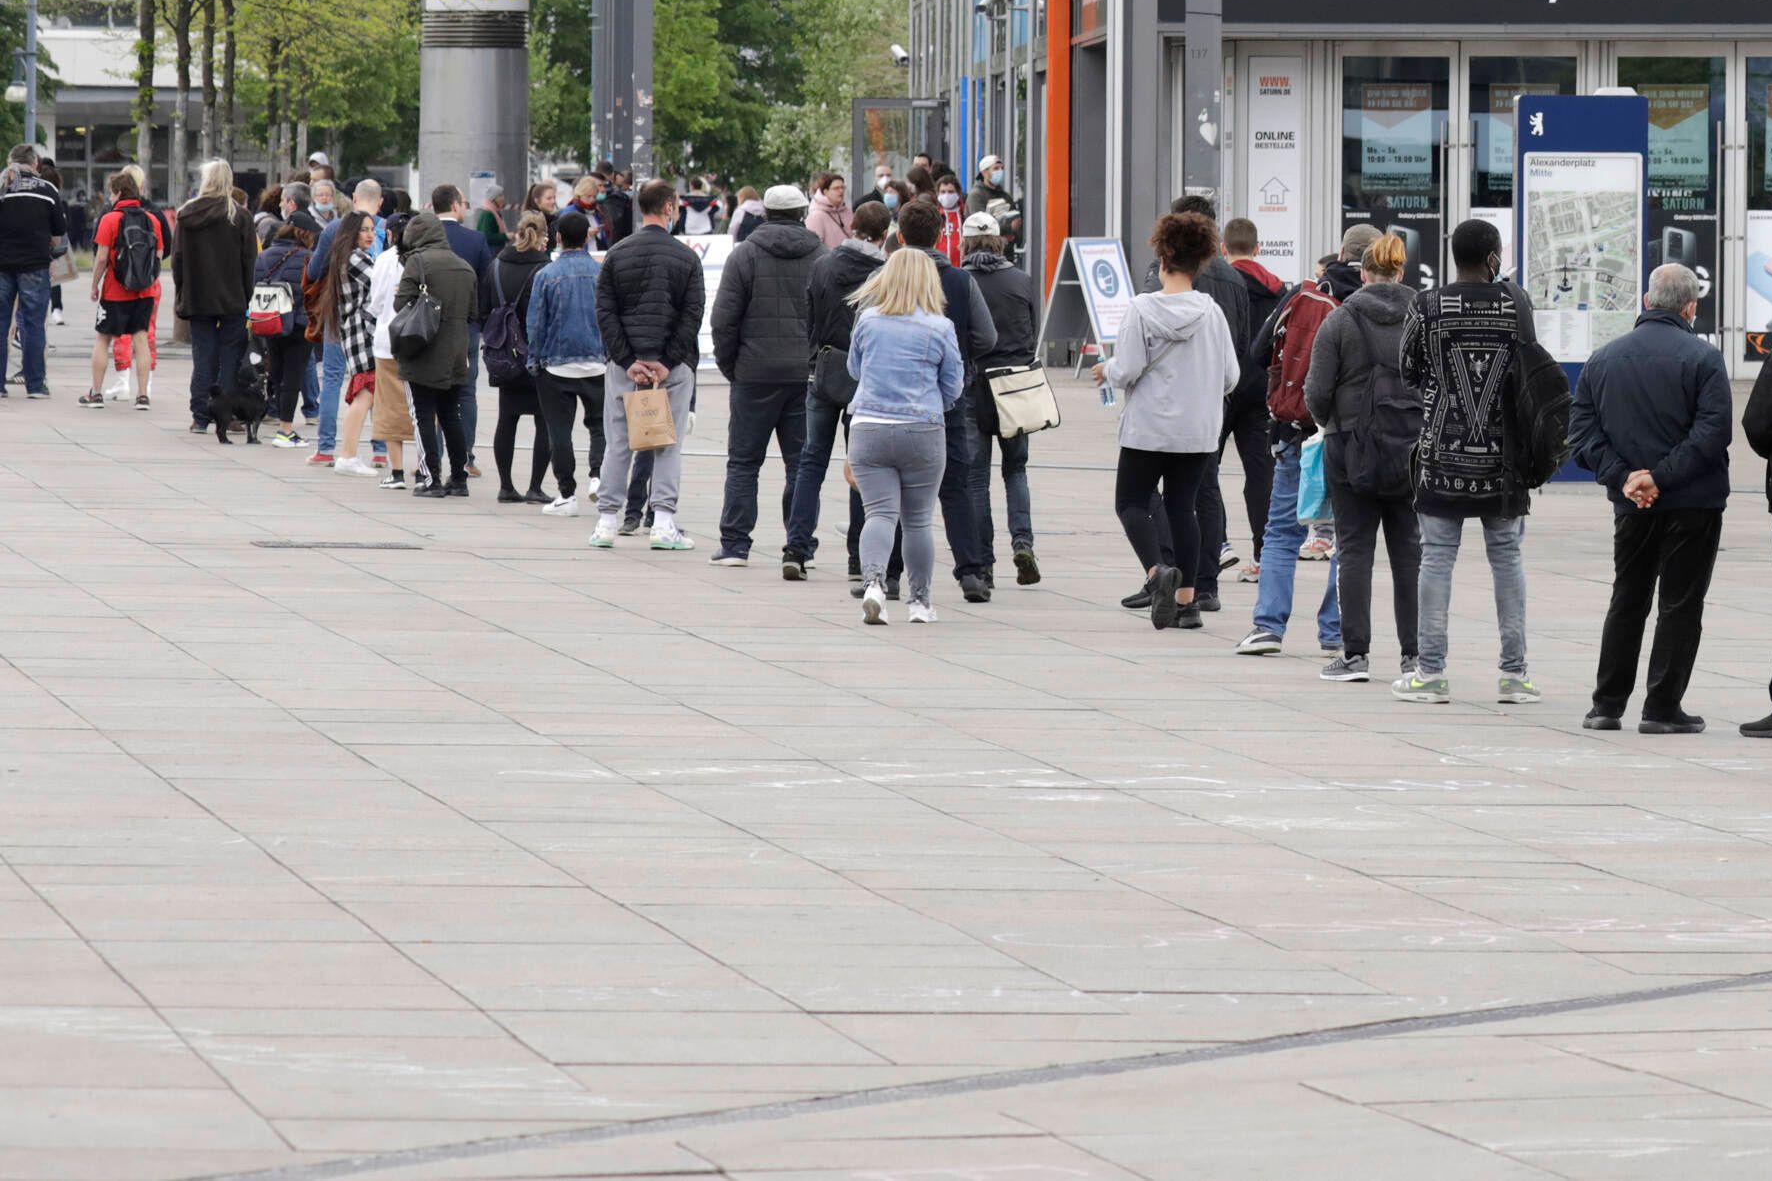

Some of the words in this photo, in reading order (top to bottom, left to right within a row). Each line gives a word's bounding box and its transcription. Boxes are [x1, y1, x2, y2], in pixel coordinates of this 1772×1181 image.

[1259, 76, 1292, 87] WWW.
[1255, 131, 1296, 141] ONLINE
[1255, 141, 1296, 149] BESTELLEN
[1530, 158, 1596, 168] Alexanderplatz
[1530, 169, 1553, 178] Mitte
[1386, 196, 1428, 209] SATURN
[1662, 198, 1706, 210] SATURN
[1266, 240, 1295, 248] MARKT
